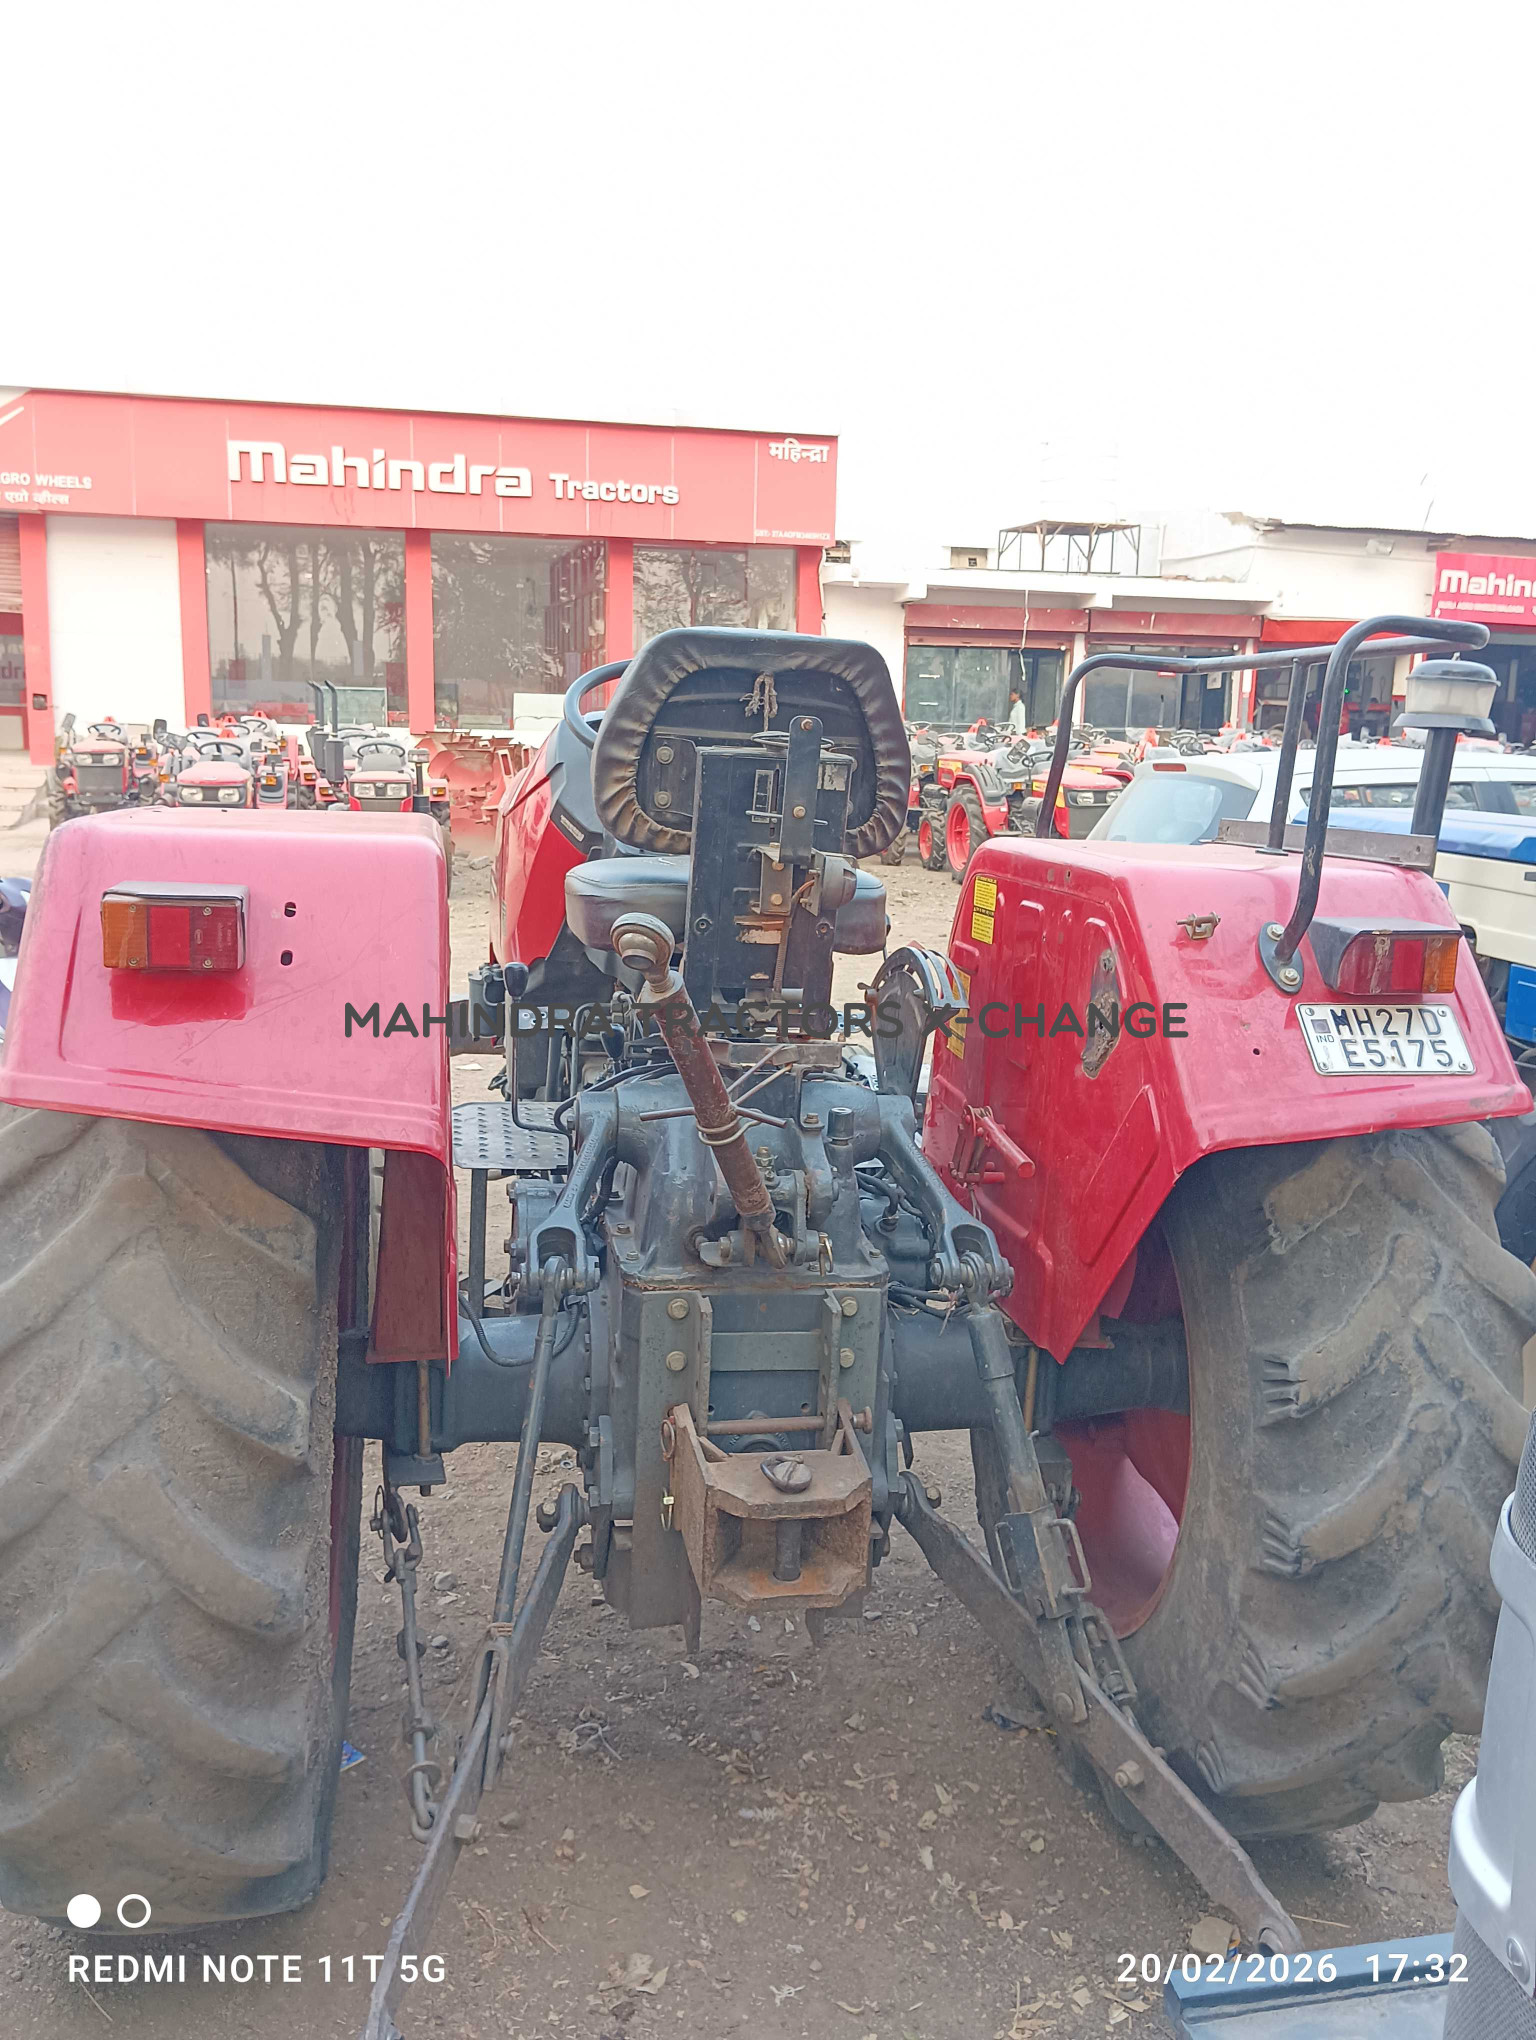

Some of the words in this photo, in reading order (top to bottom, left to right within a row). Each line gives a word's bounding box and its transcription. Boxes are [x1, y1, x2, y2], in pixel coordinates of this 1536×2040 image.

[767, 437, 830, 463] महिन्द्रा
[0, 471, 31, 487] GRO
[34, 473, 93, 491] WHEELS
[227, 438, 534, 499] Mahindra
[548, 472, 681, 505] Tractors
[1438, 568, 1536, 599] Mahin
[1329, 1008, 1442, 1037] MH27D
[1315, 1034, 1336, 1044] IND
[1339, 1038, 1454, 1068] E5175
